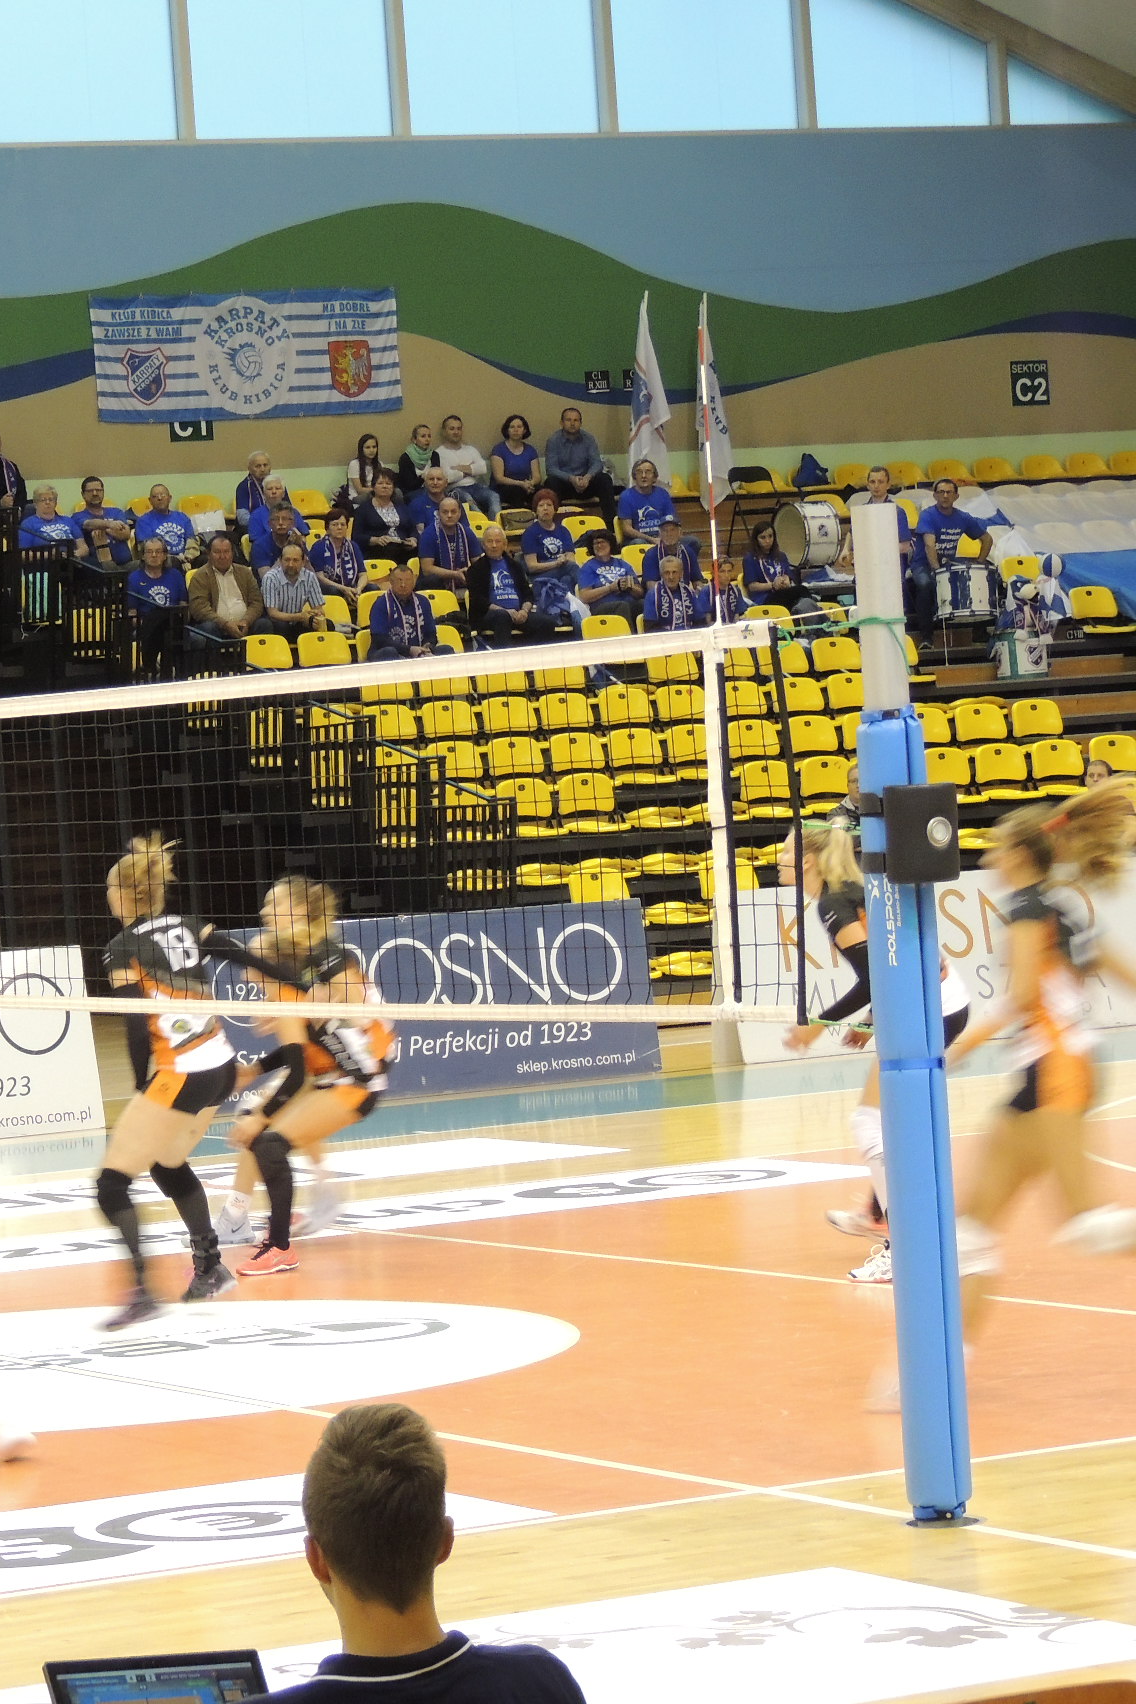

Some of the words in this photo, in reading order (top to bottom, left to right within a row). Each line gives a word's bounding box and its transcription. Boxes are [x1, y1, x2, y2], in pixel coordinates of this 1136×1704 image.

[111, 310, 136, 321] KLUB
[139, 310, 172, 320] KIBICA
[322, 303, 335, 313] NA
[338, 302, 371, 313] DOBRE
[104, 327, 143, 338] ZAWSZE
[146, 327, 152, 337] Z
[155, 326, 182, 337] WAMI
[203, 306, 291, 342] KARPATY
[214, 322, 275, 349] KROSNO
[335, 320, 347, 330] NA
[131, 354, 161, 386] KARPATY
[136, 368, 160, 392] KROSNO
[1011, 363, 1048, 374] SEKTOR
[209, 363, 238, 401] KLUB
[244, 361, 286, 404] KIBICA
[1015, 377, 1048, 402] C2
[409, 1028, 500, 1060] Perfekcji
[505, 1023, 532, 1049] od
[540, 1021, 592, 1046] 1923
[516, 1049, 637, 1075] sklep.krosno.com.pl
